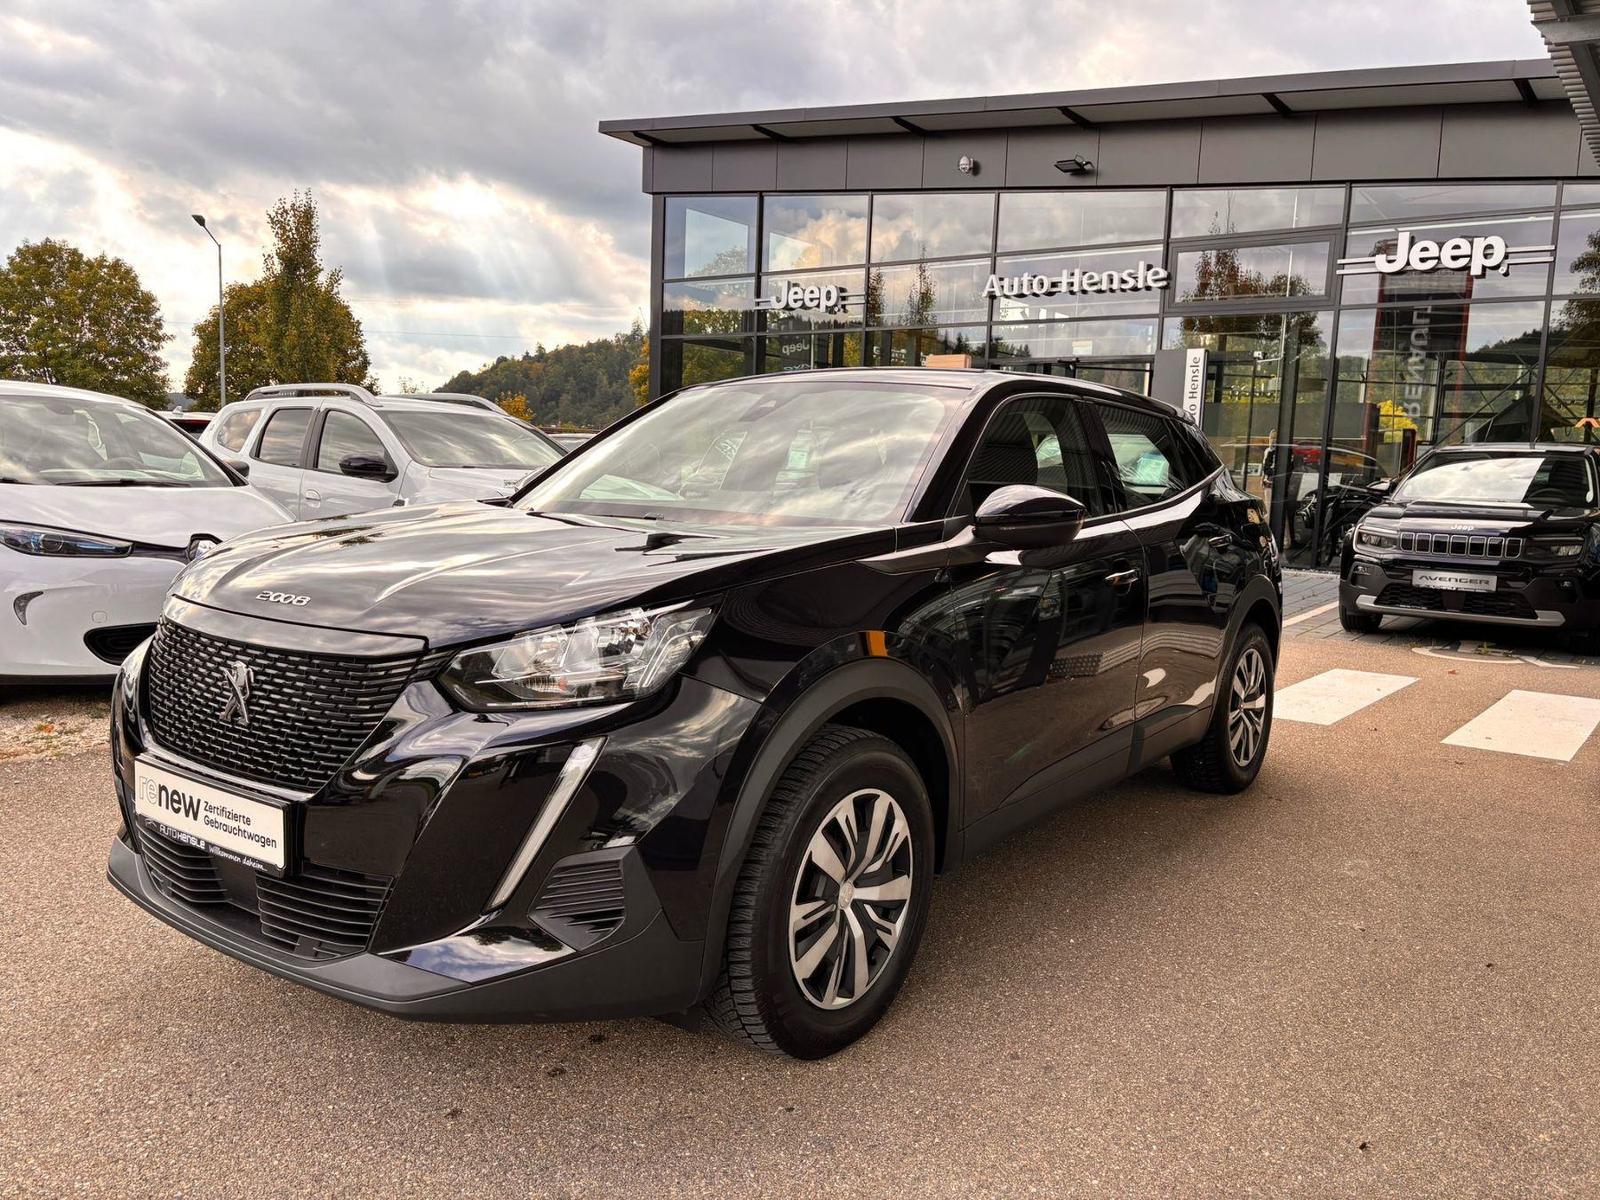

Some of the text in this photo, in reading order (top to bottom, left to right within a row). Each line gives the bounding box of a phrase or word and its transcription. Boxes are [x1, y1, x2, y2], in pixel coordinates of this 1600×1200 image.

[1375, 231, 1507, 276] Jeep
[982, 260, 1169, 298] Auto Hensle
[770, 280, 840, 313] Jeep
[1188, 356, 1201, 400] Hensle
[1450, 523, 1475, 532] Jeep
[1418, 575, 1490, 586] AVENGER
[255, 590, 311, 606] 2008
[138, 775, 202, 822] renew
[203, 800, 252, 827] Zertifizierte
[203, 814, 278, 849] Gebrauchtwagen
